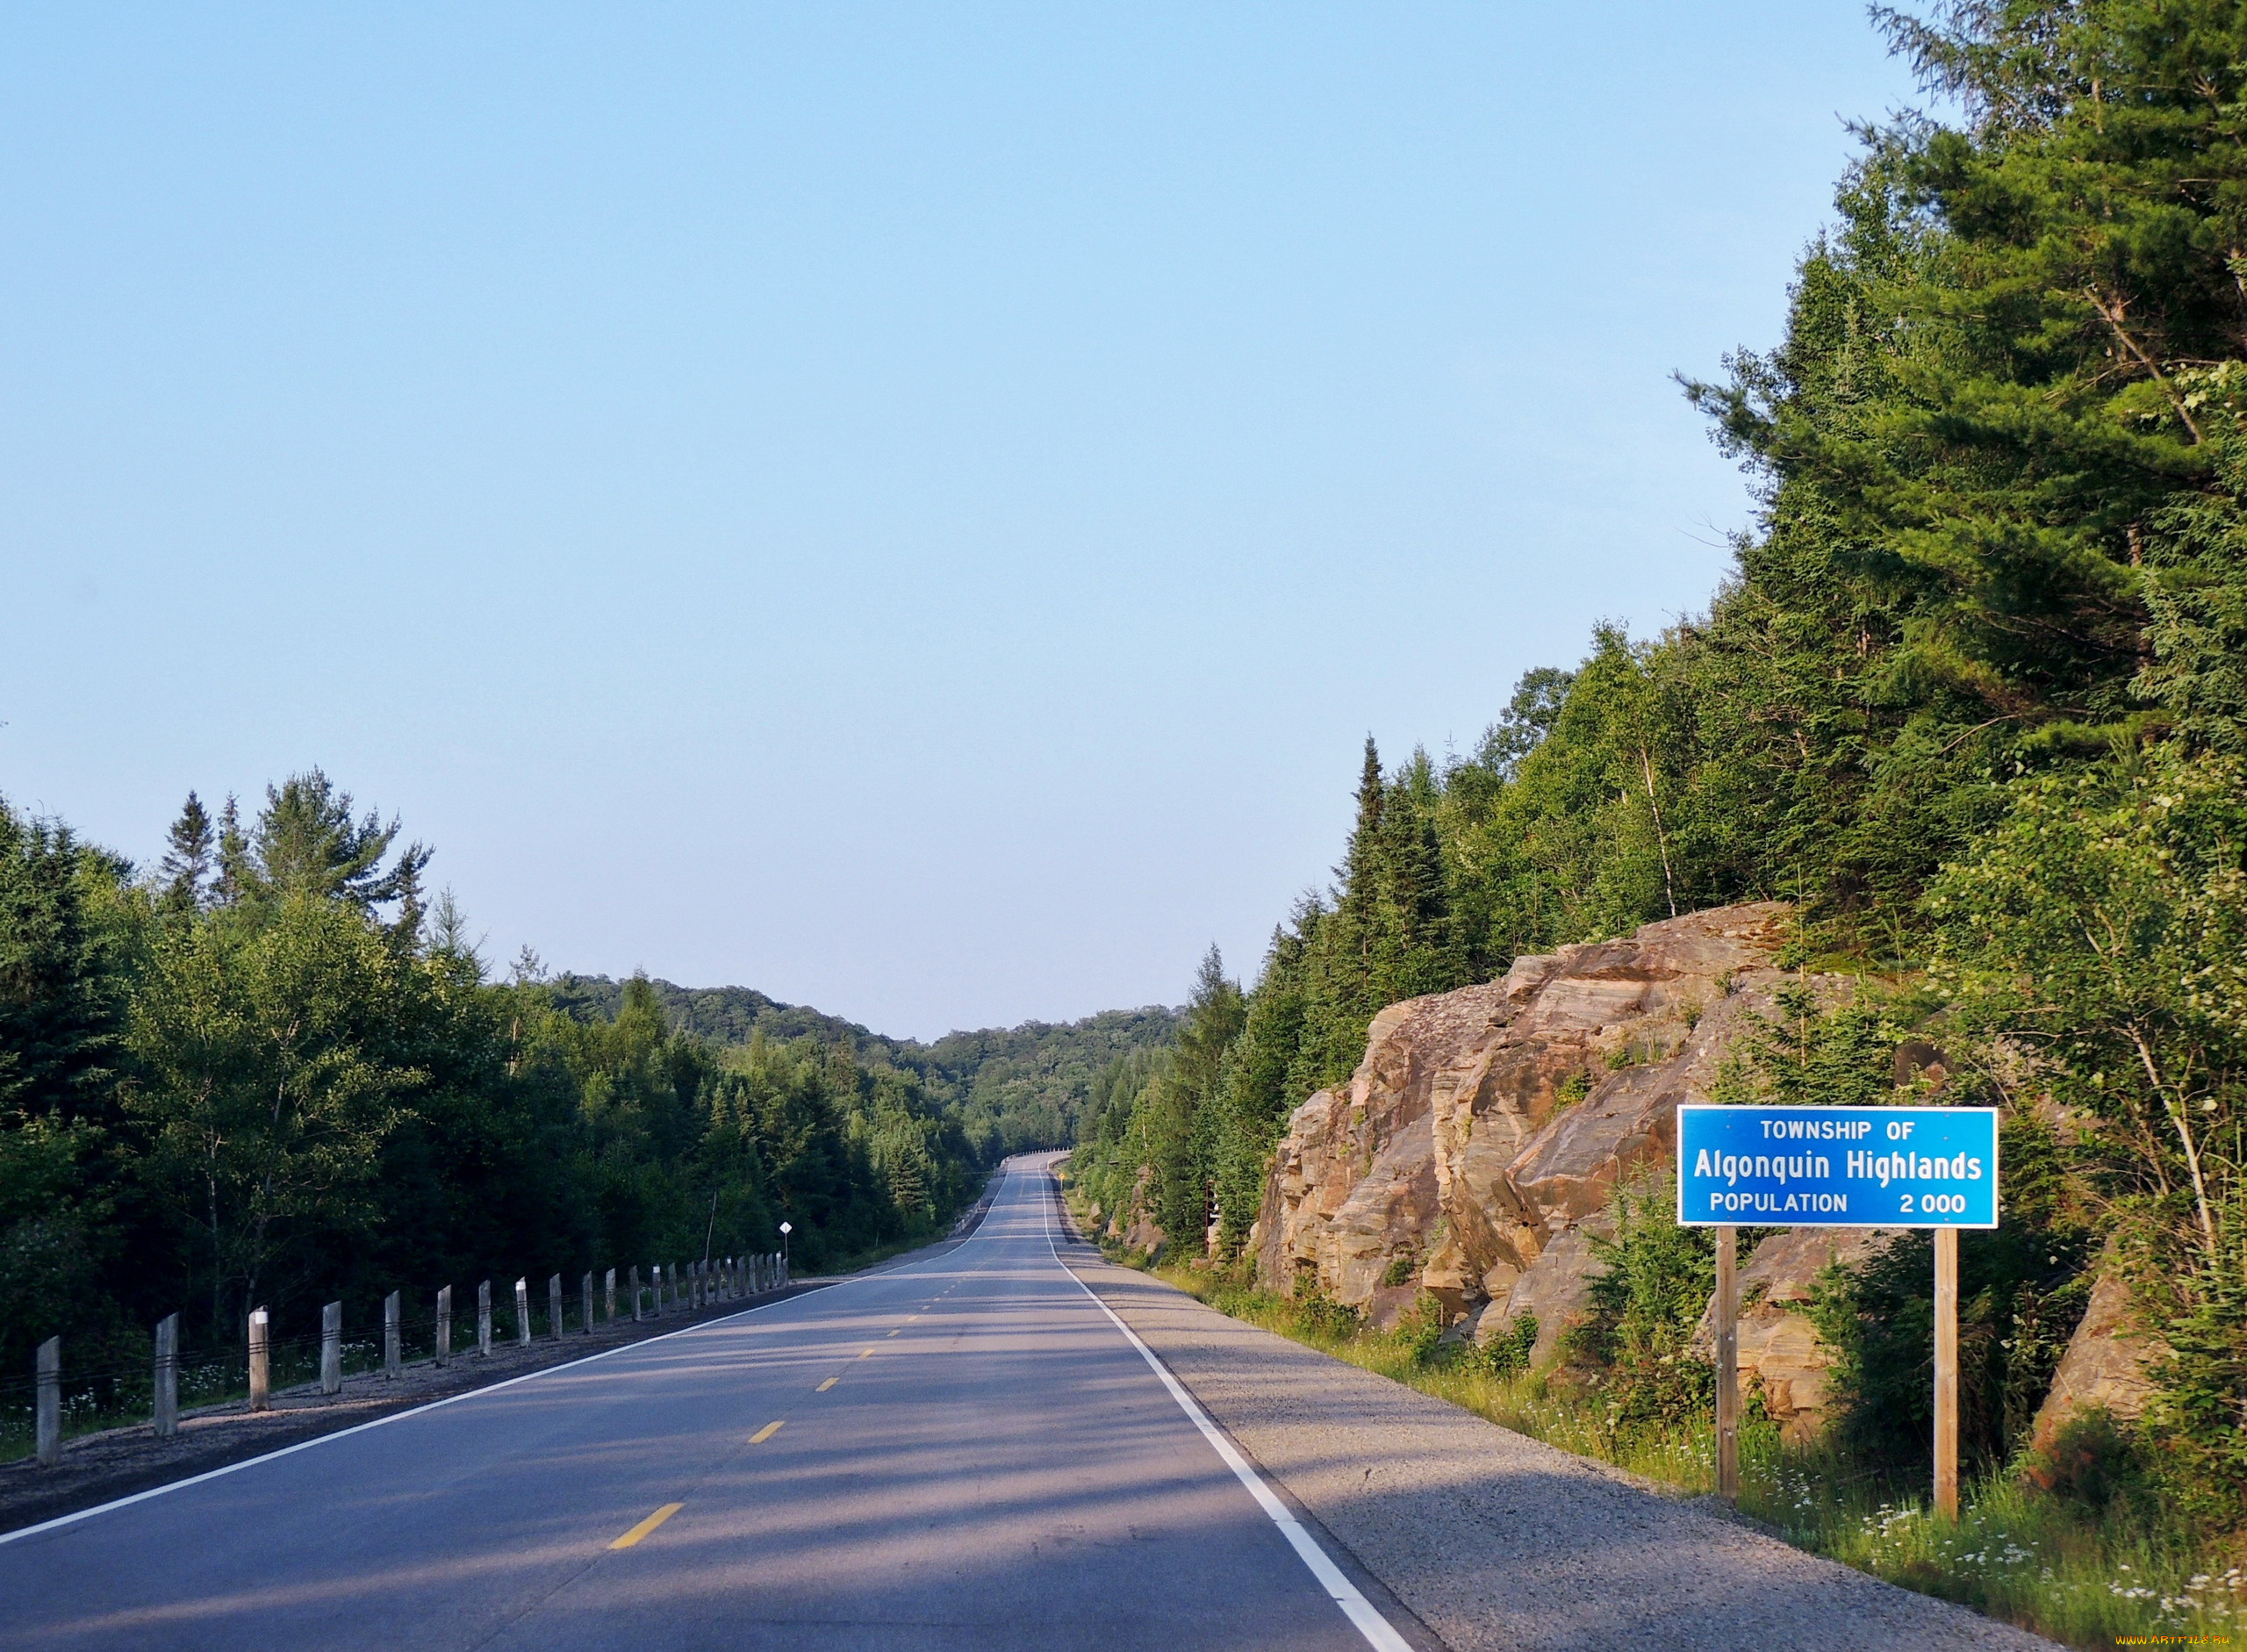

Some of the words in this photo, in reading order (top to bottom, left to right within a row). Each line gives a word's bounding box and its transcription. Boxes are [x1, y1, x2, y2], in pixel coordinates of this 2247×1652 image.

[1761, 1120, 1871, 1140] TOWNSHIP
[1886, 1121, 1915, 1140] OF
[1694, 1148, 1829, 1187] Algonquin
[1847, 1150, 1982, 1189] Highlands
[1710, 1193, 1848, 1212] POPULATION
